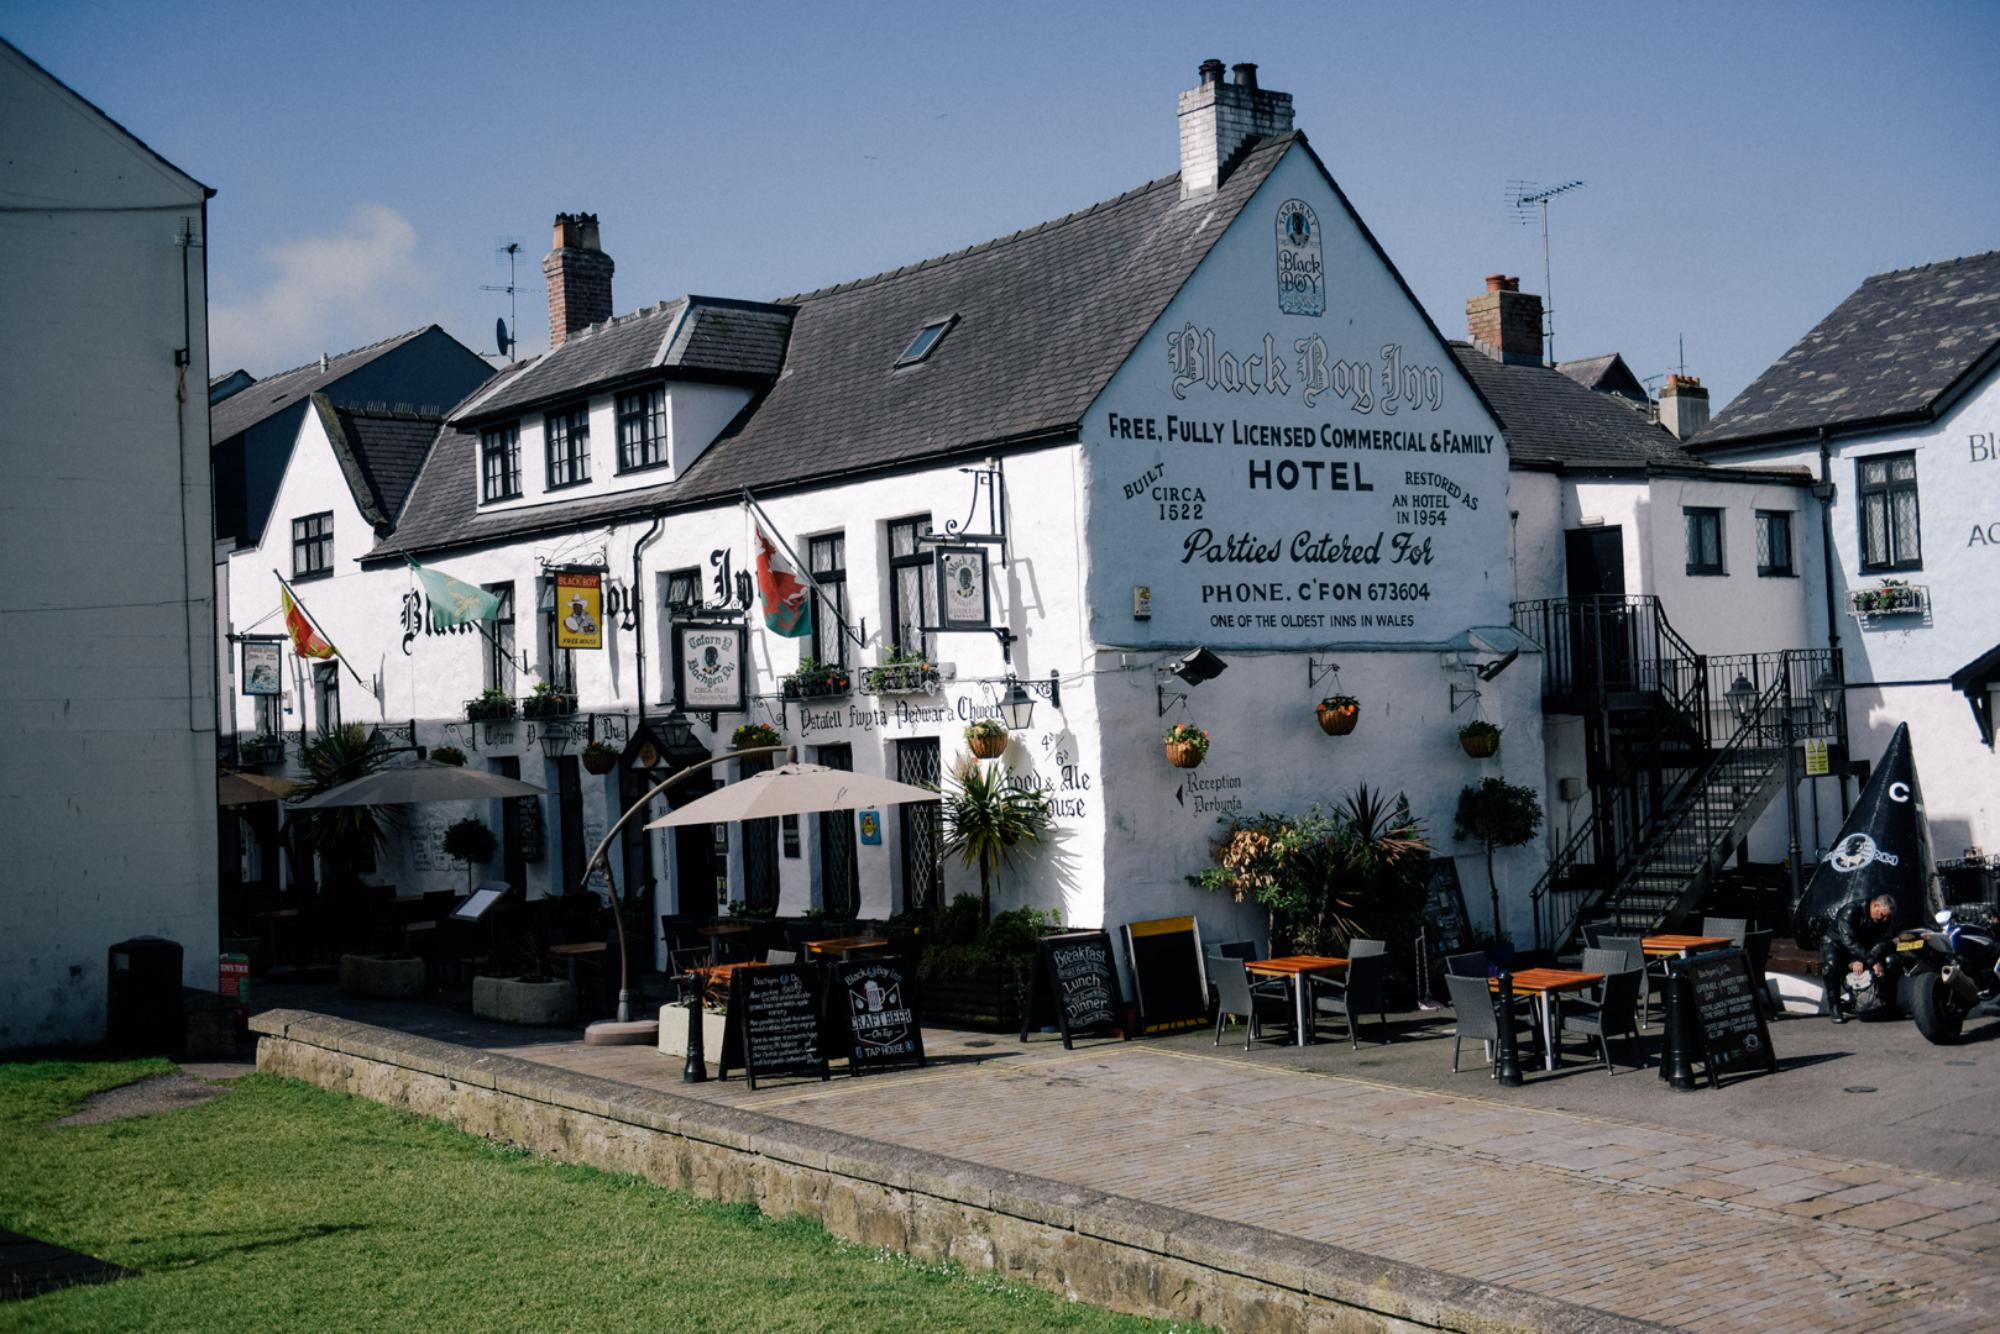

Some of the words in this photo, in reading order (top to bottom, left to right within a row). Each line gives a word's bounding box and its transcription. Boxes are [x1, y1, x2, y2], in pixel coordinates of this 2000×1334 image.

[1279, 202, 1313, 225] TAFARN
[1279, 249, 1324, 274] Black
[1167, 322, 1291, 400] Black
[1294, 332, 1375, 415] Boy
[1380, 344, 1444, 415] Inn
[1167, 415, 1225, 444] FULLY
[1232, 419, 1316, 447] LICENSED
[1321, 423, 1428, 453] COMMERCIAL
[1969, 432, 2000, 463] Bl
[1123, 462, 1165, 500] BUILT
[1248, 459, 1374, 492] HOTEL
[1151, 486, 1207, 502] CIRCA
[1392, 494, 1408, 508] AN
[1412, 494, 1450, 508] HOTEL
[1405, 471, 1462, 499] RESTORED
[1461, 492, 1479, 511] AS
[1160, 503, 1203, 520] 1522
[1397, 511, 1410, 524] IN
[1414, 509, 1447, 526] 1954
[1181, 528, 1282, 564] Parties
[1290, 530, 1384, 564] Catered
[1390, 531, 1435, 566] For
[558, 576, 581, 586] BLACK
[582, 577, 597, 587] BOY
[710, 547, 761, 611] In
[1368, 582, 1430, 601] 673604
[601, 586, 636, 631] oy
[1210, 614, 1235, 628] ONE
[1237, 614, 1253, 628] OF
[1255, 614, 1277, 628] THE
[1281, 614, 1325, 628] OLDEST
[1331, 614, 1357, 628] INNS
[1361, 614, 1373, 627] IN
[1376, 614, 1414, 628] WALES
[1061, 765, 1091, 791] Ale
[1186, 771, 1241, 796] Reception
[1889, 782, 1909, 802] C
[1046, 797, 1086, 818] ouse
[1053, 946, 1107, 968] Breakfast
[844, 968, 867, 986] Black
[1062, 973, 1101, 993] Lunch
[1066, 998, 1108, 1018] Dinner
[850, 1012, 884, 1031] CRAFT
[886, 1008, 912, 1026] BEER
[864, 1047, 880, 1057] TAP
